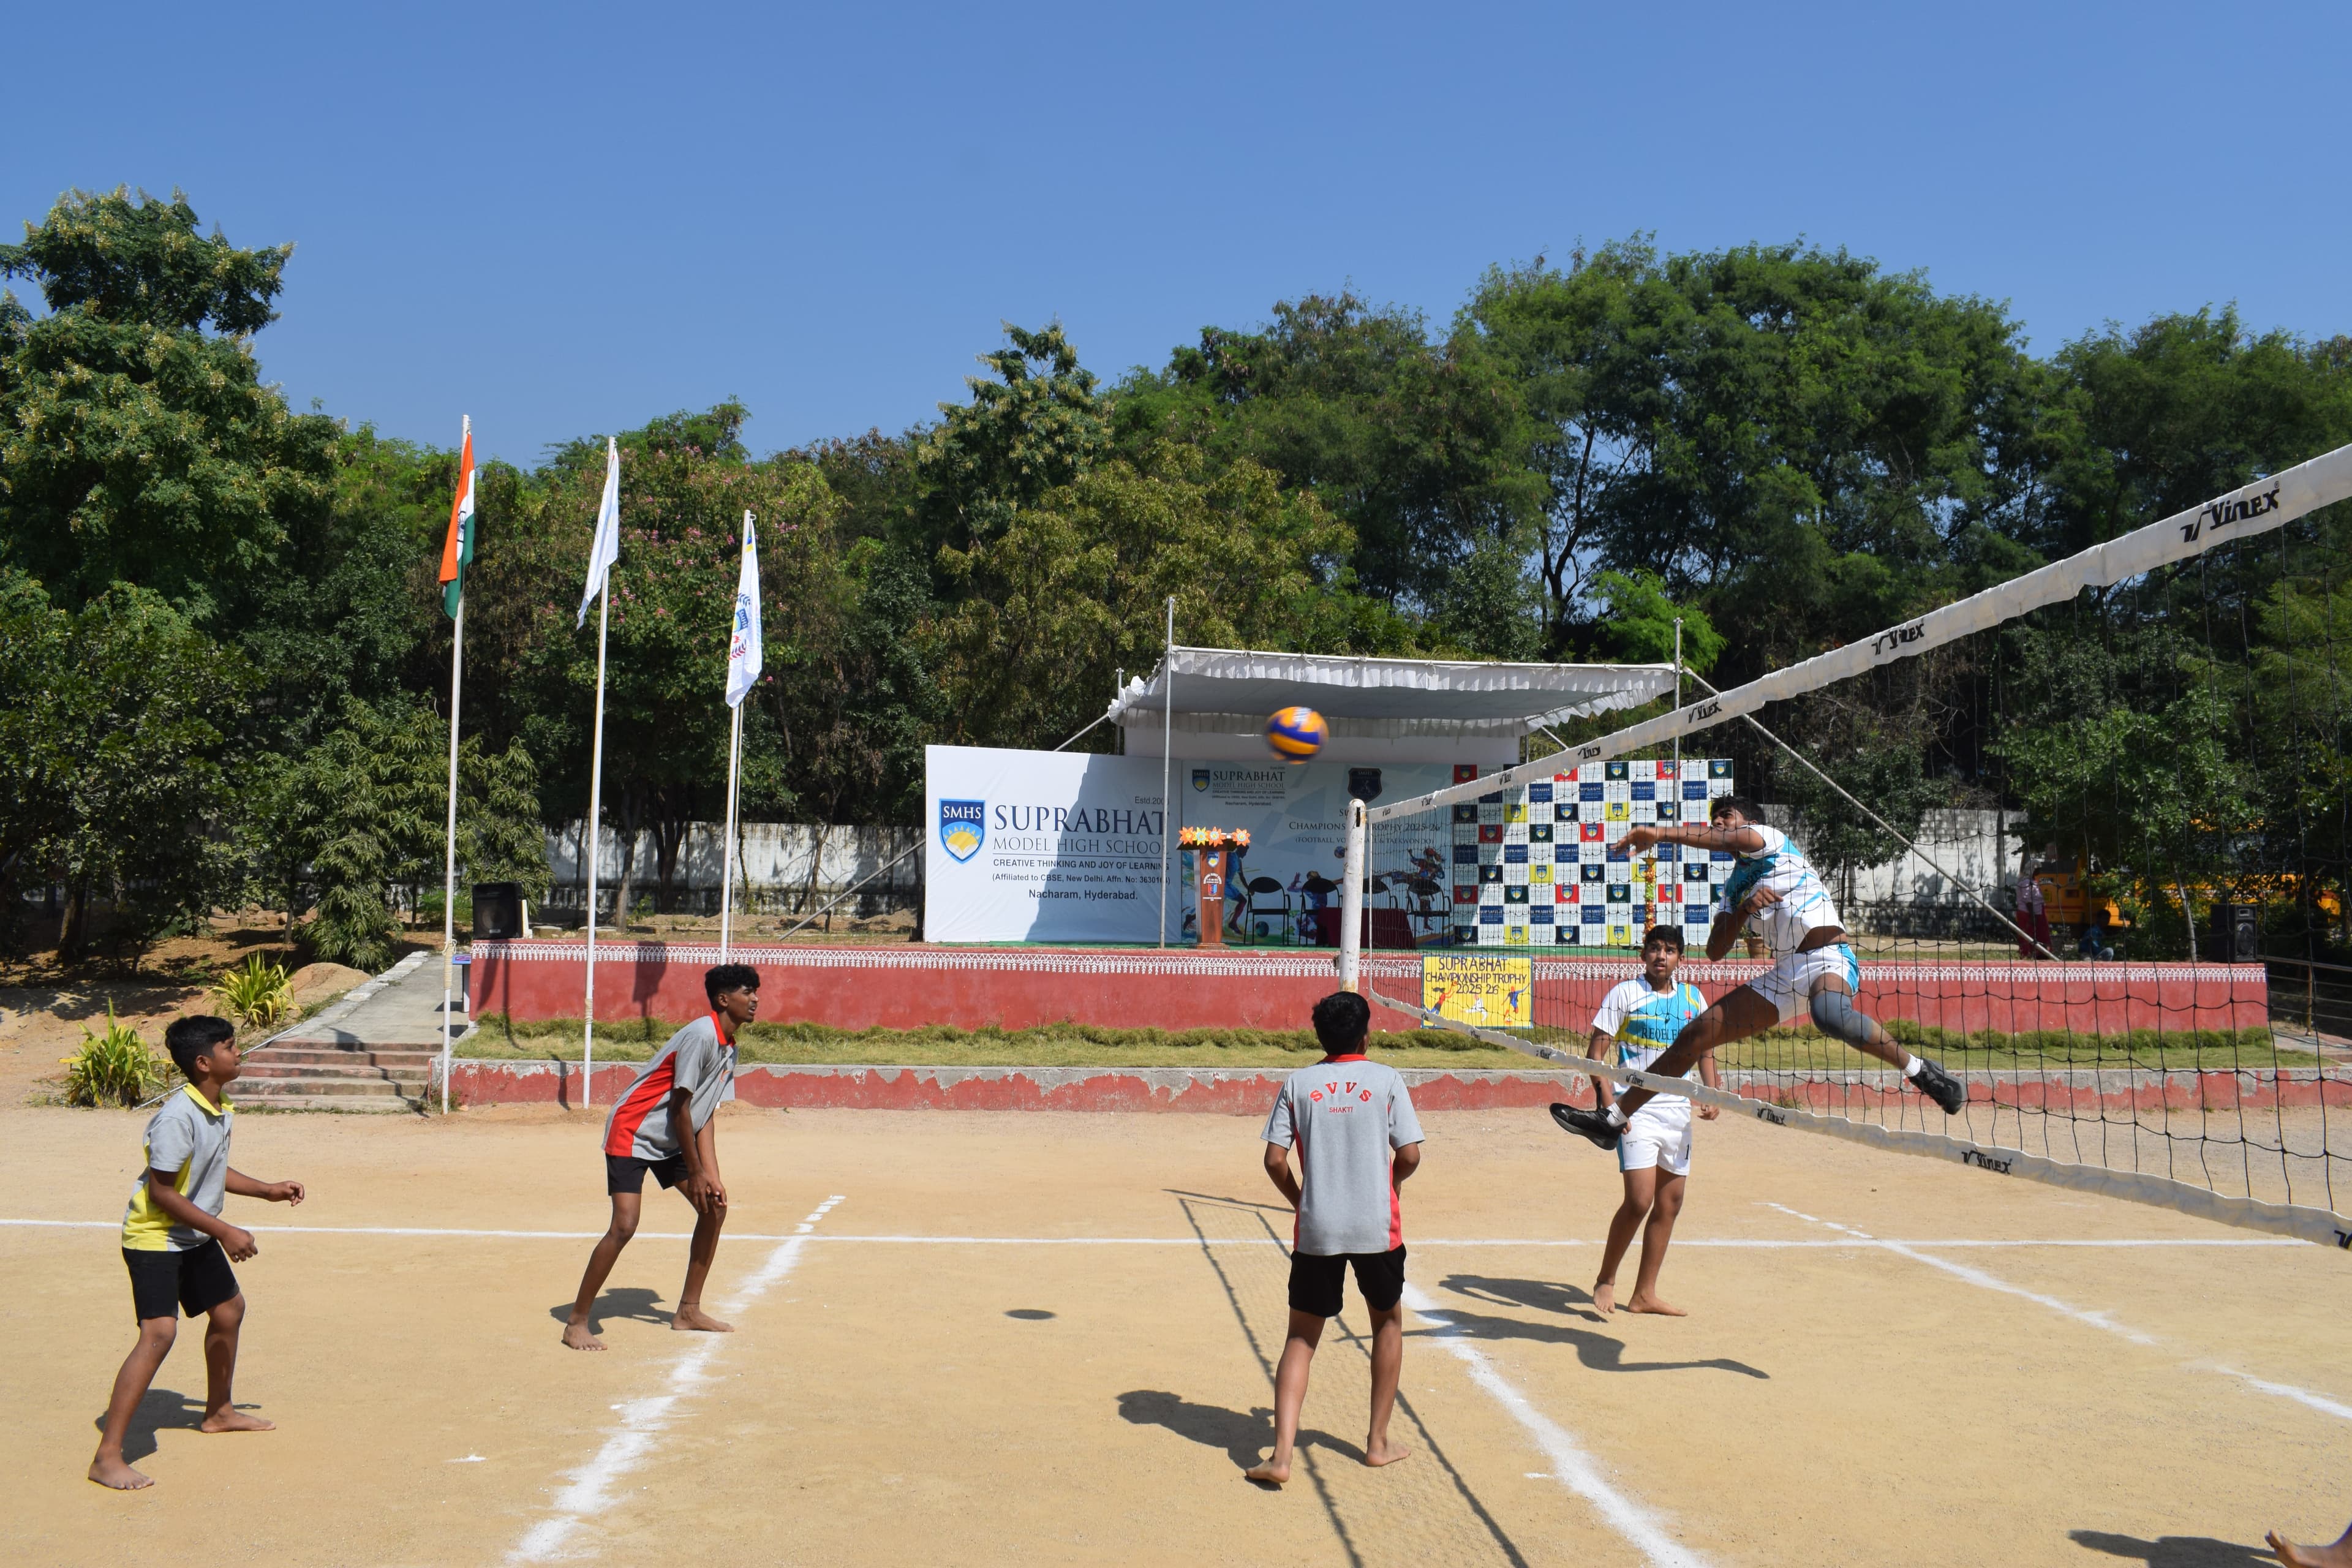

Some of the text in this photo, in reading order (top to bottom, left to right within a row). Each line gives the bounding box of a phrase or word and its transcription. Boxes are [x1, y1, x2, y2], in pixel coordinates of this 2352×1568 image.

[1213, 771, 1285, 781] SUPRABHAT
[1135, 796, 1169, 805] Estd.200
[943, 806, 981, 819] SMHS
[995, 804, 1170, 835] SUPRABHAT
[1289, 821, 1346, 831] CHAMPIONS
[993, 836, 1050, 851] MODEL
[1057, 839, 1099, 853] HIGH
[993, 859, 1035, 867] CREATIVE
[992, 873, 1029, 882] (Affiliated
[1041, 874, 1064, 883] CBSE,
[1029, 889, 1138, 901] Nacharam, Hyderabad.
[1439, 957, 1507, 971] SUPRABHAT
[1425, 972, 1527, 984] CHAMPIONSHIP TROPHY
[1456, 982, 1499, 995] 2025 26
